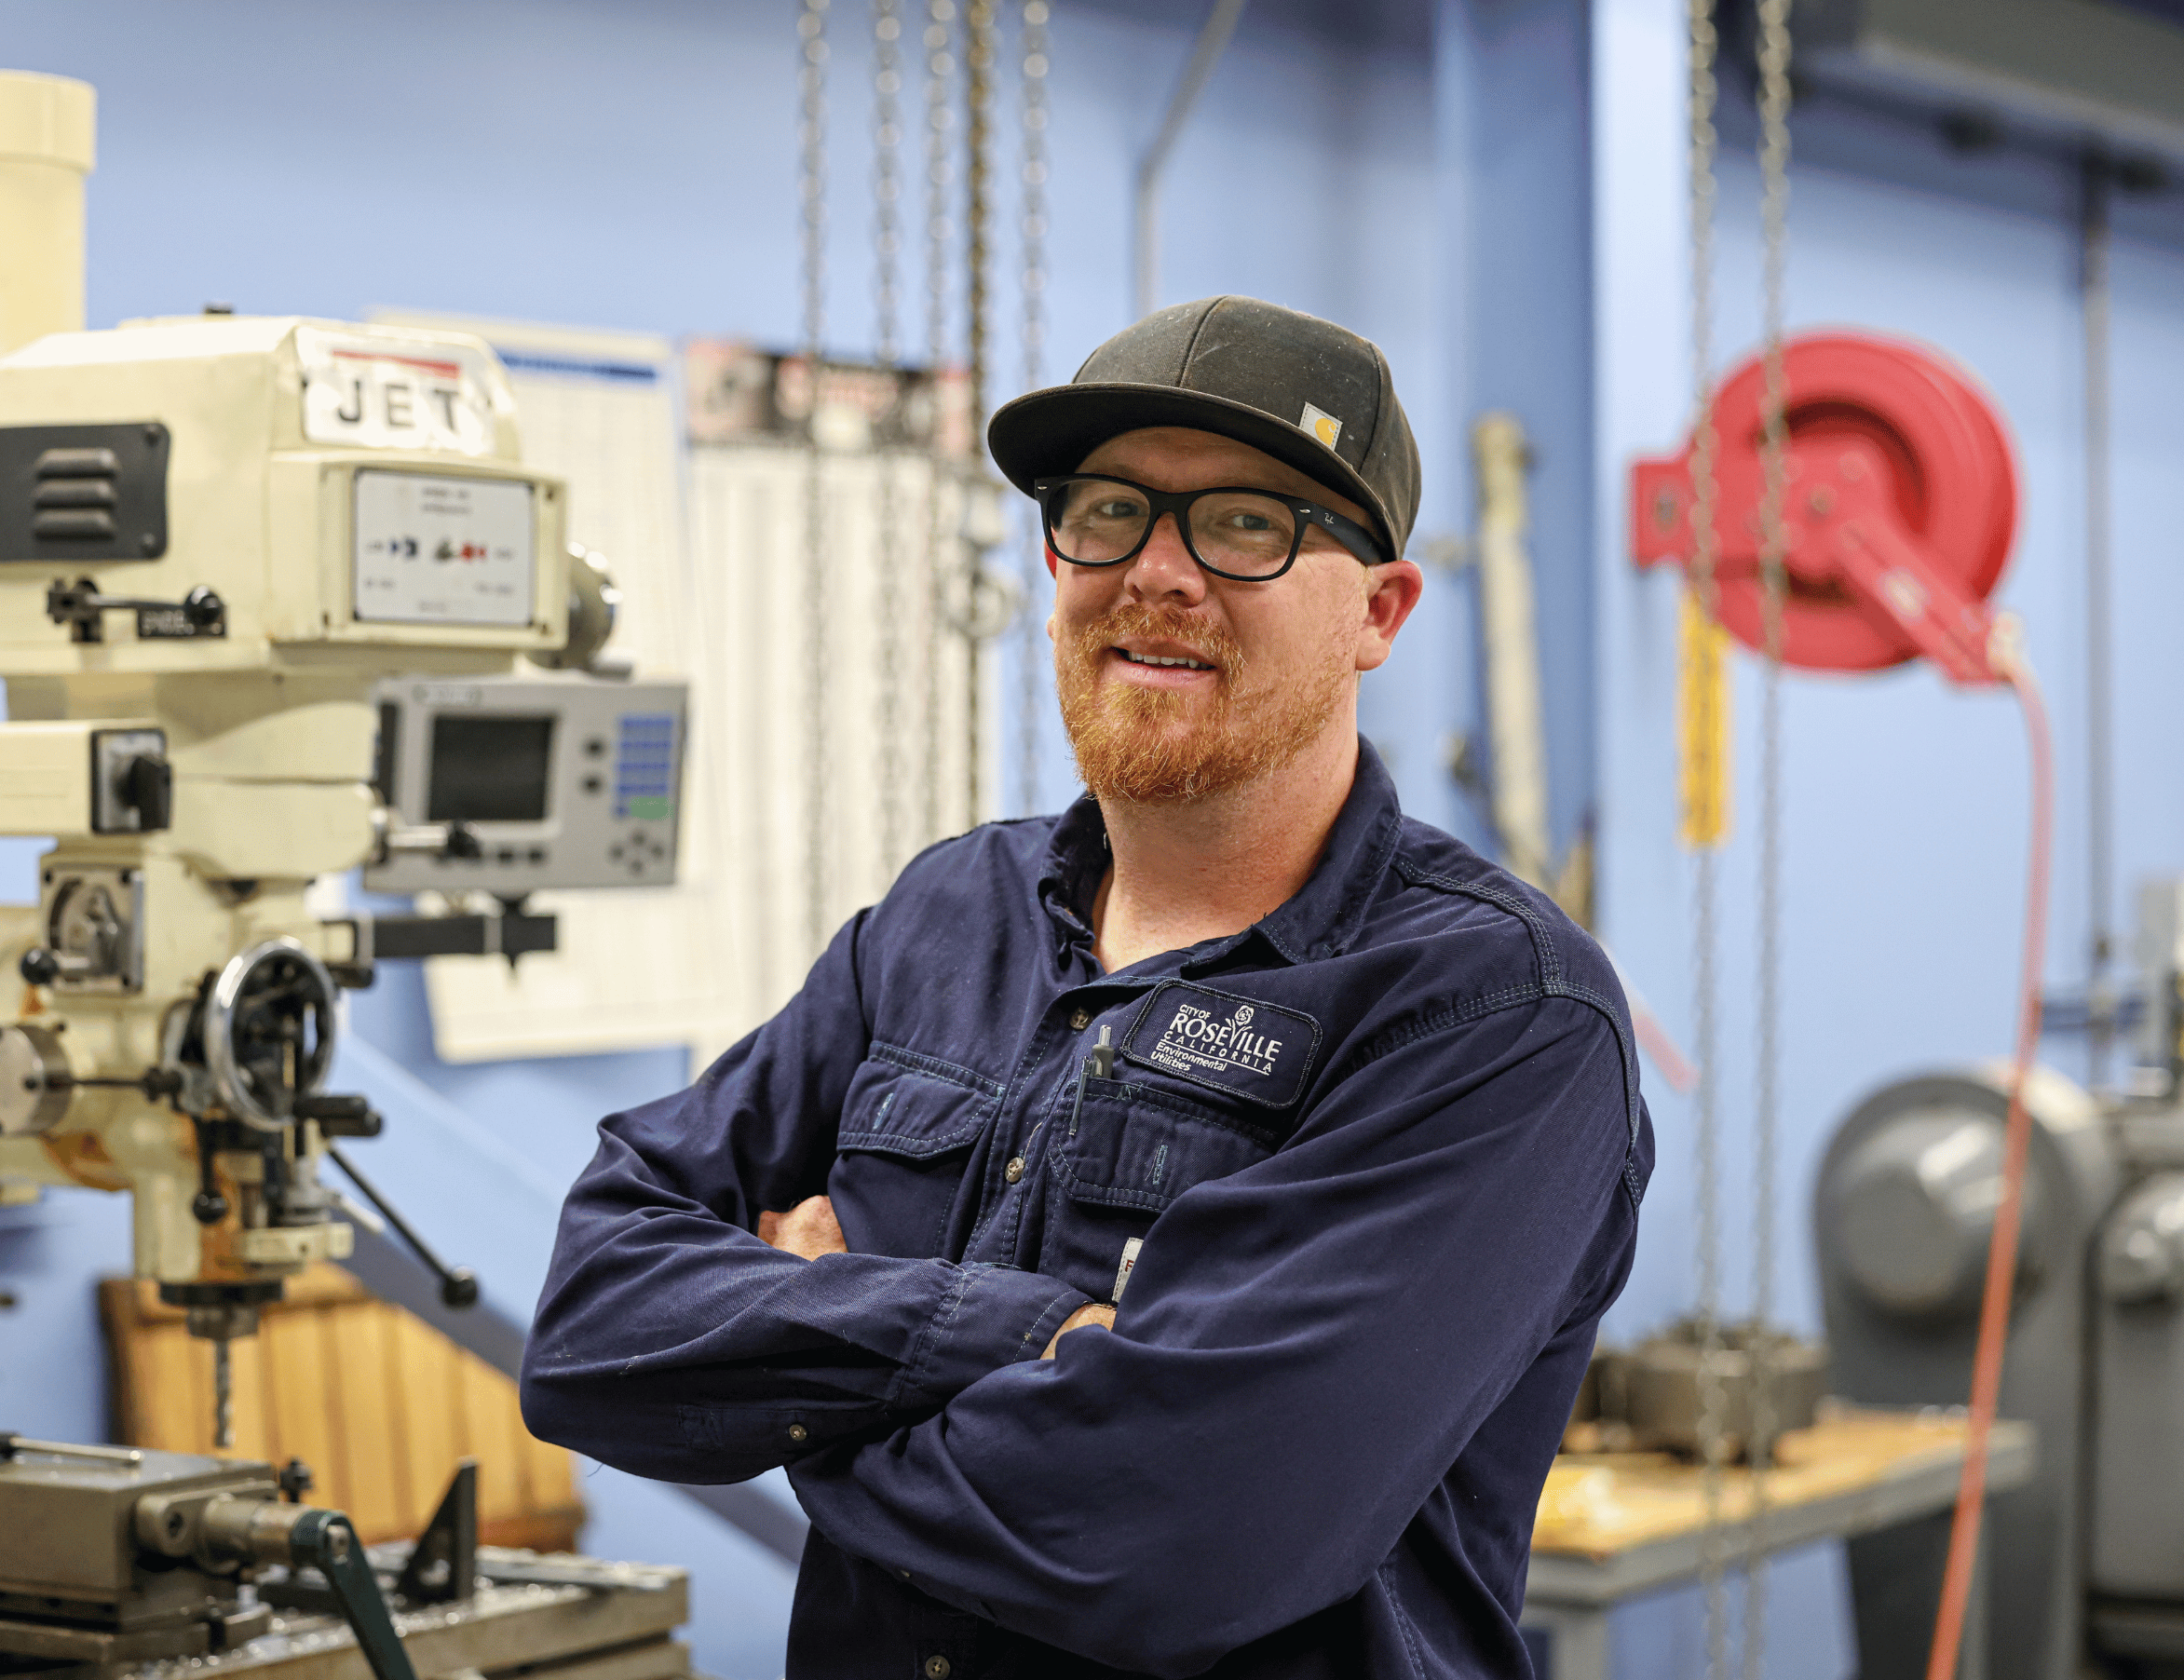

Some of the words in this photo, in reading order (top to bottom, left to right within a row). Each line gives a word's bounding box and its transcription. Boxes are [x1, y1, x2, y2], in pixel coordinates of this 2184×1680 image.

[337, 379, 460, 432] JET
[1179, 1004, 1200, 1017] CITY
[1198, 1009, 1212, 1021] OF
[1162, 1031, 1273, 1073] CALIFORNIA
[1169, 1012, 1282, 1063] ROSEVILLE
[1150, 1050, 1192, 1071] Utilities
[1156, 1042, 1228, 1072] Environmental
